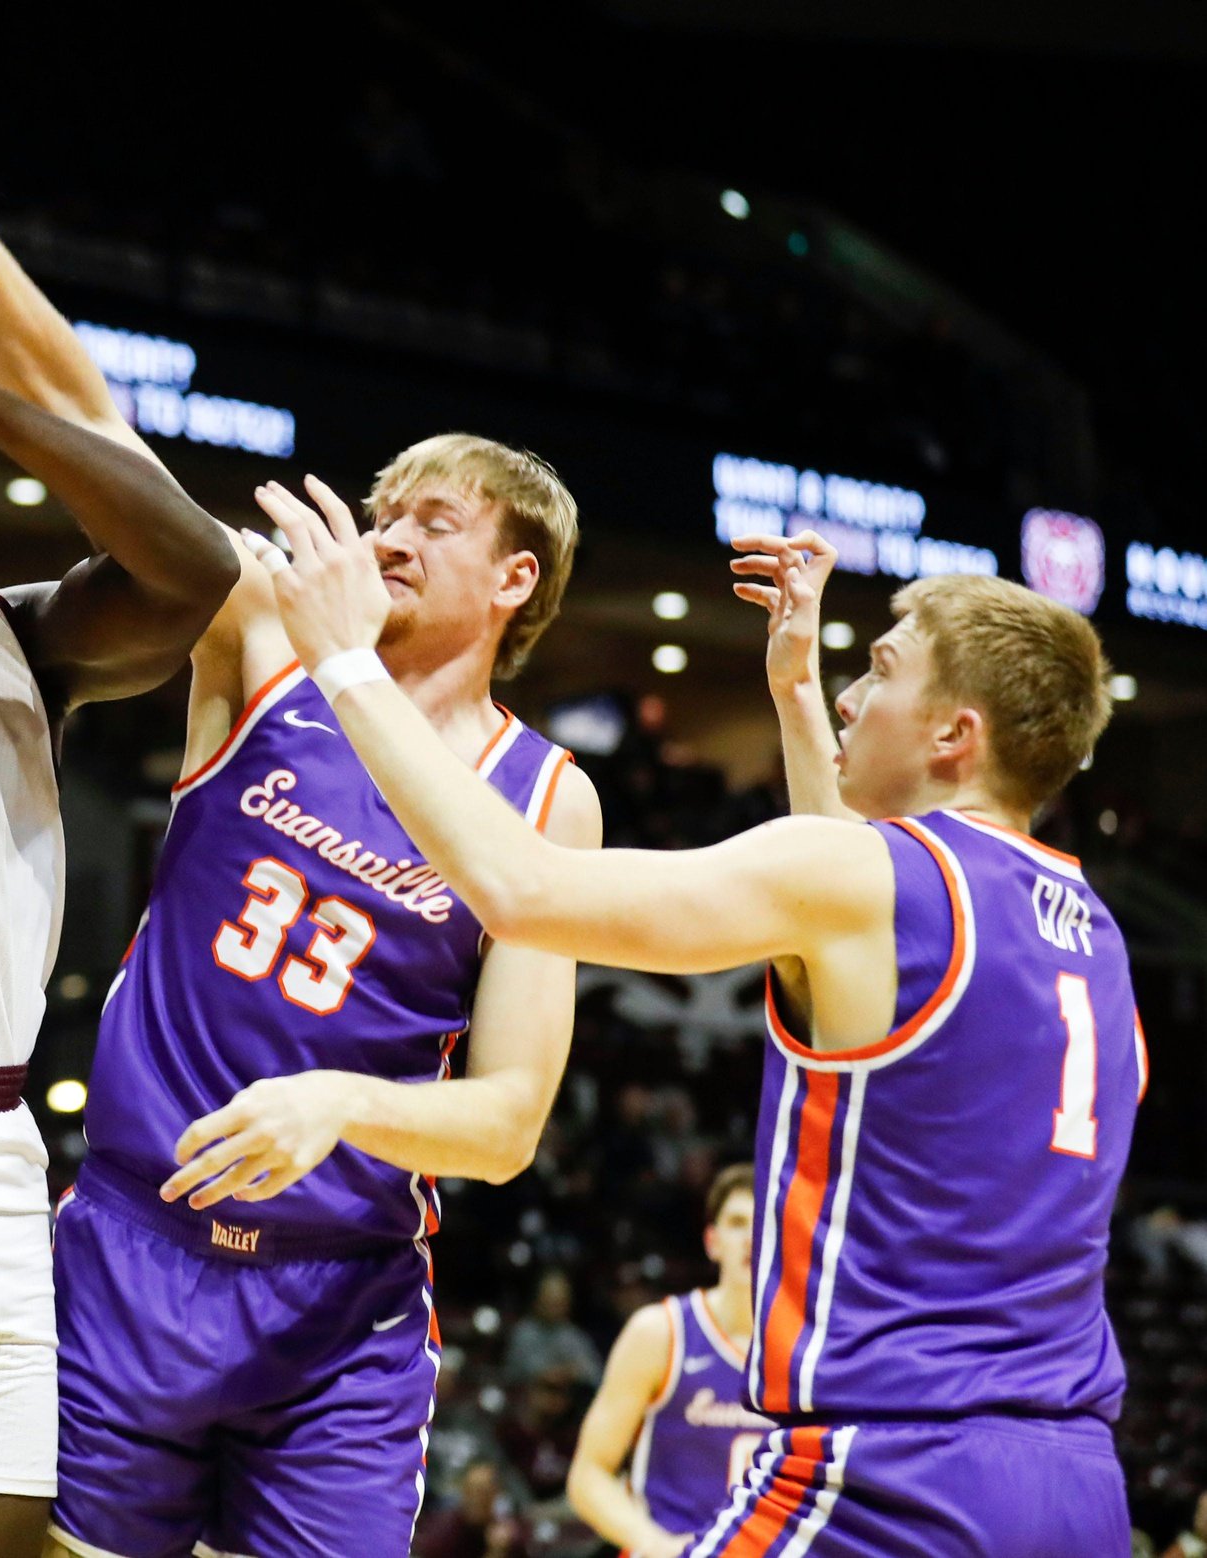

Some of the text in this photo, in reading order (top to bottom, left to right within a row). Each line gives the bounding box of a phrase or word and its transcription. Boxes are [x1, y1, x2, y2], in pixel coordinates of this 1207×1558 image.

[240, 769, 453, 924] Evansville
[1031, 873, 1094, 957] CUFF
[212, 856, 376, 1016] 33
[1048, 970, 1099, 1161] 1
[211, 1219, 260, 1252] VALLEY
